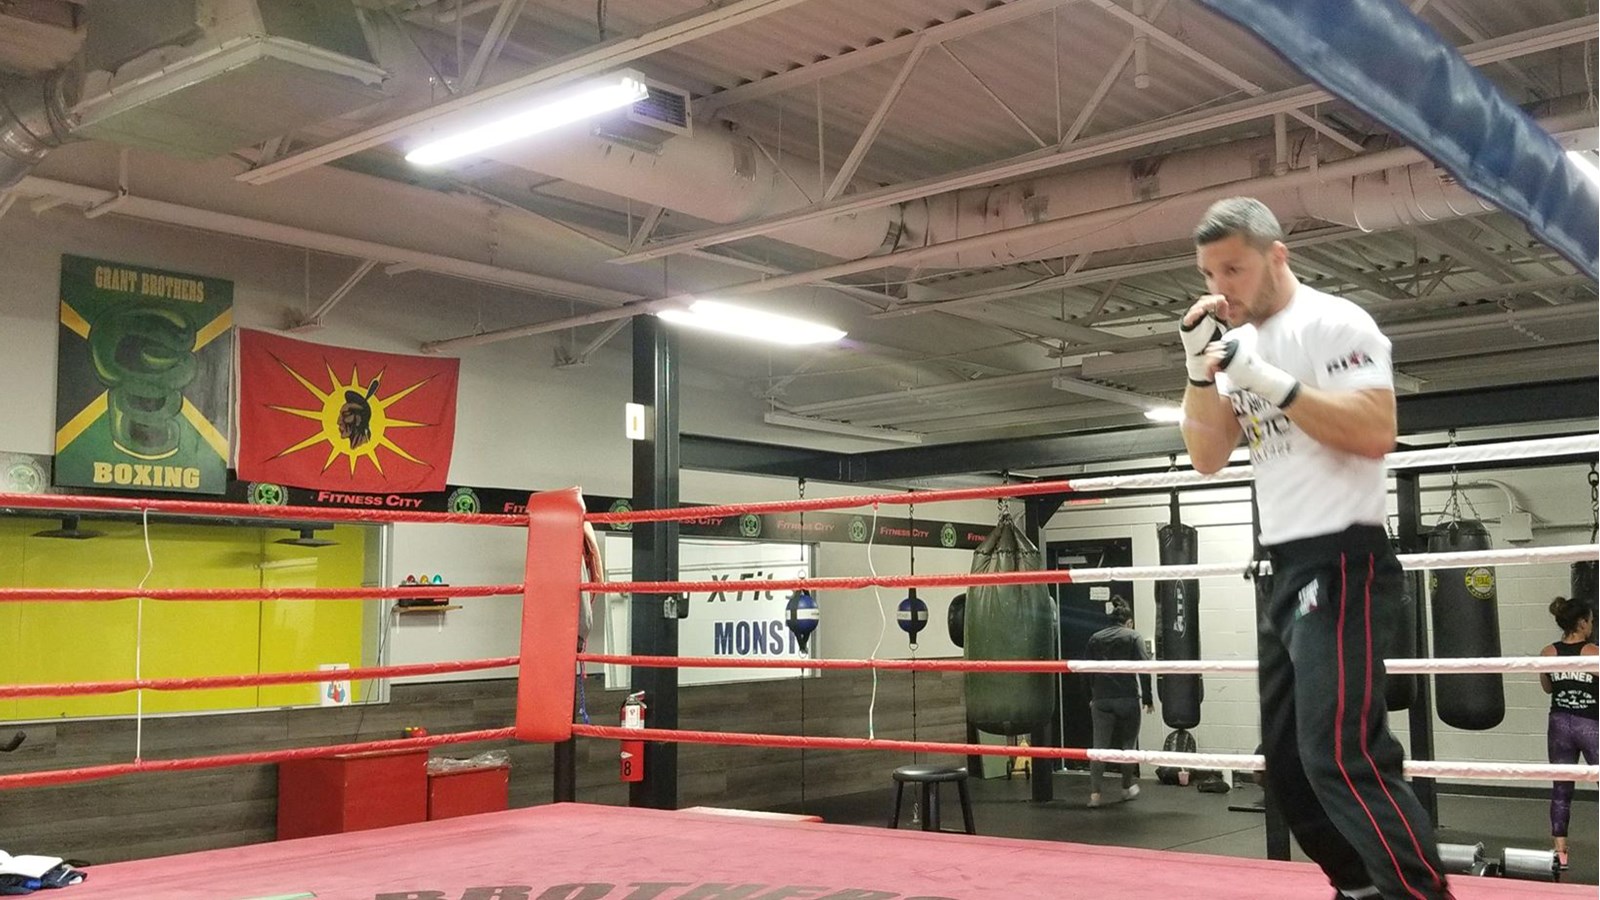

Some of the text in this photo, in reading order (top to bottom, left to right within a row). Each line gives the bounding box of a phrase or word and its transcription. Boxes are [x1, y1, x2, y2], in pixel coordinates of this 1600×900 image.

[95, 265, 205, 303] GRANT BROTHERS
[93, 461, 200, 489] BOXING
[317, 490, 423, 508] FITNESS CITY
[502, 501, 529, 513] FIT
[911, 527, 930, 538] CITY
[1550, 670, 1593, 684] TRAINER
[623, 760, 632, 777] 8
